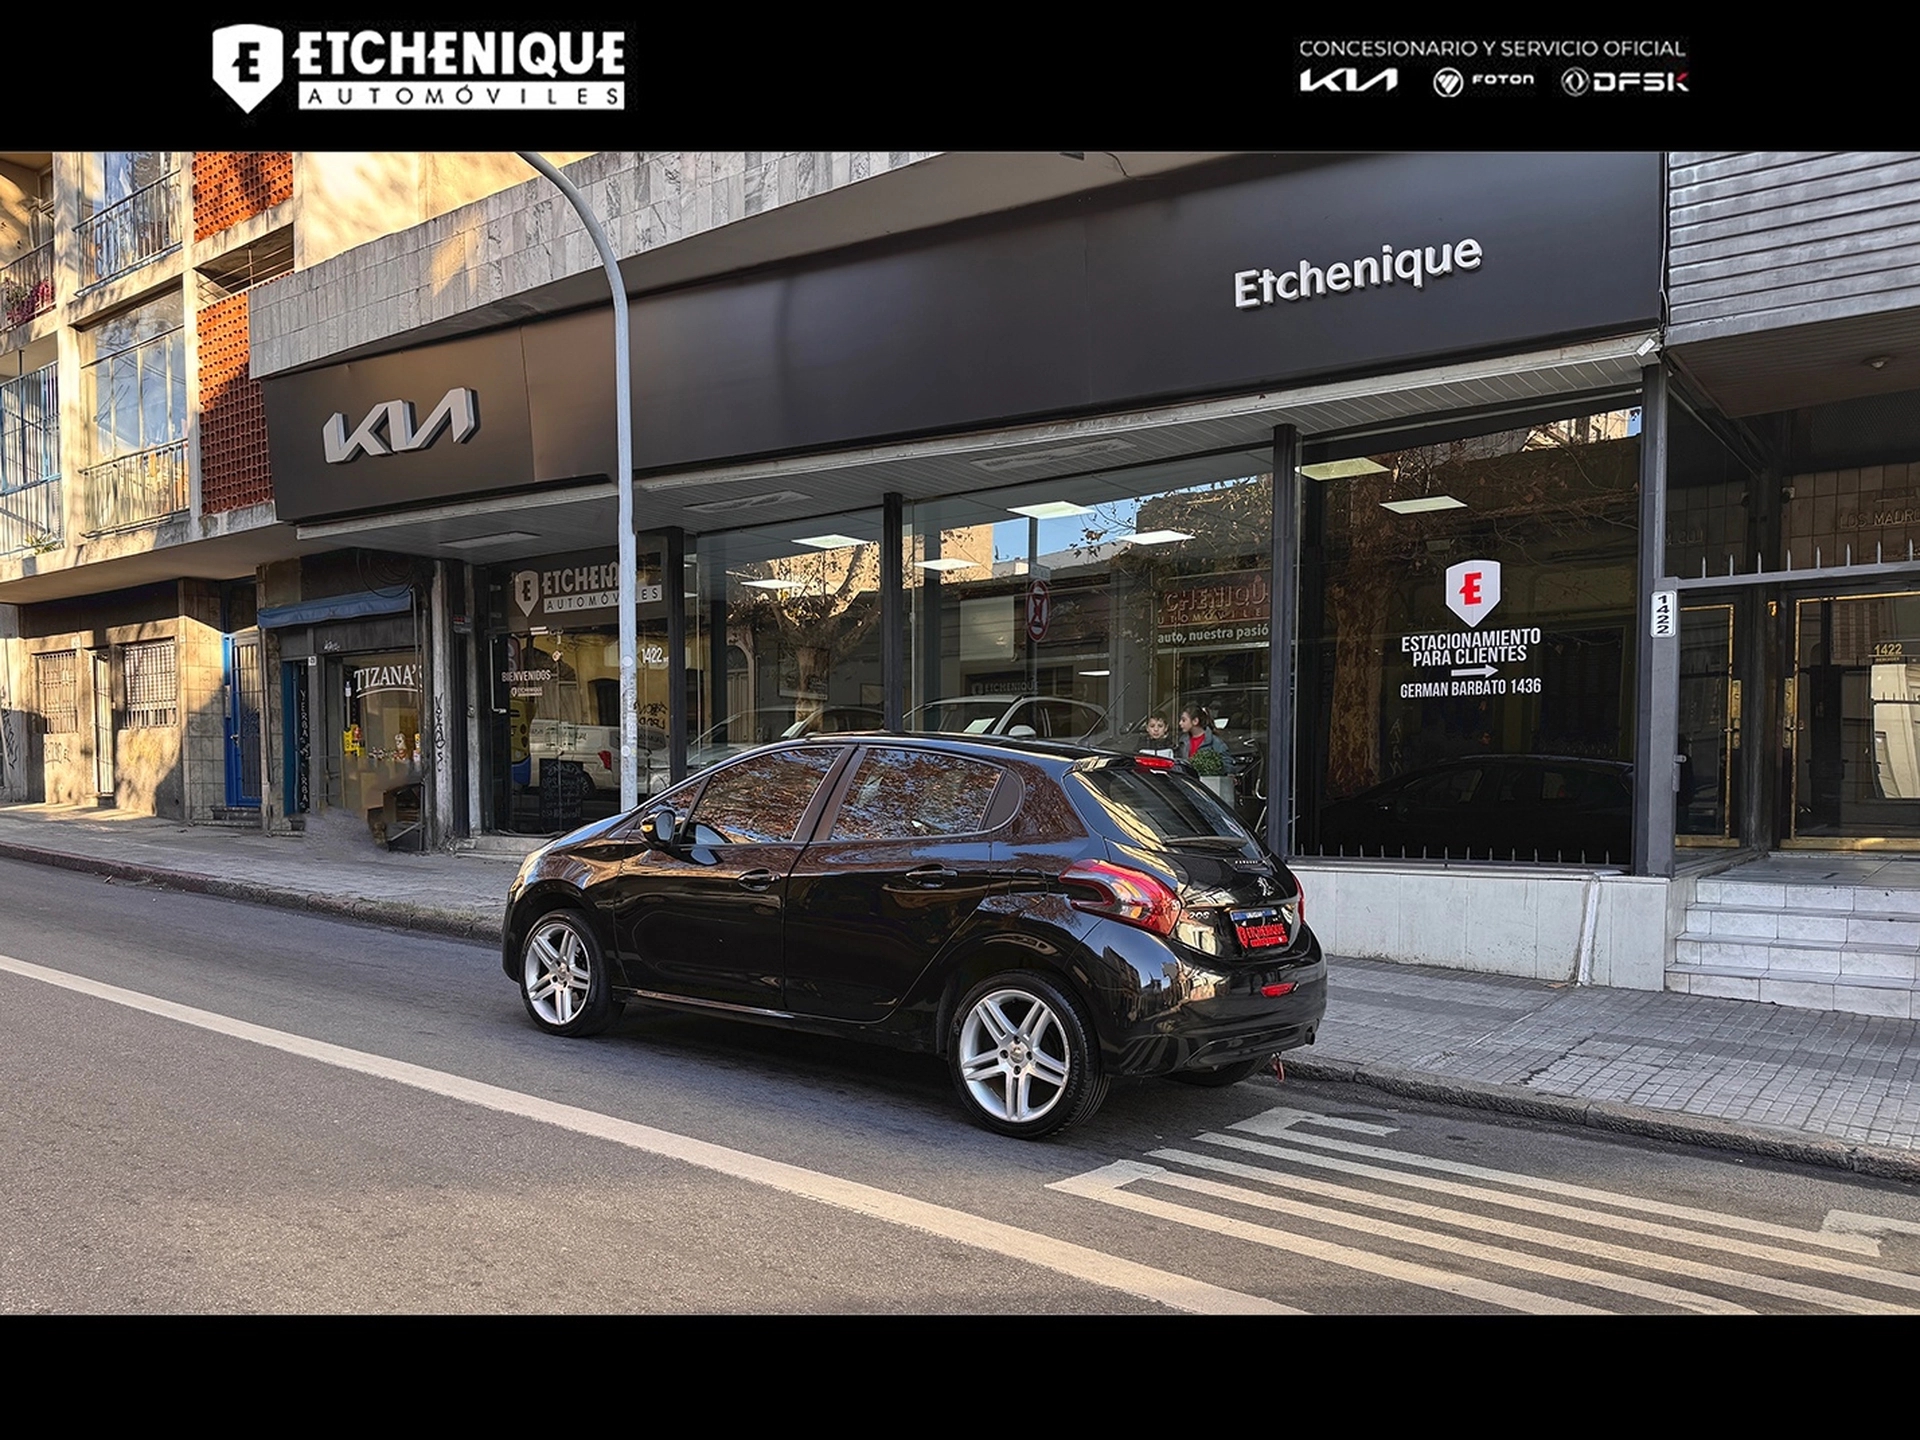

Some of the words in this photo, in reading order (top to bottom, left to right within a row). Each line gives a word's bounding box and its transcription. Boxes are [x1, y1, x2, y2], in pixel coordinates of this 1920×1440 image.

[1234, 238, 1483, 309] Etchenique
[323, 387, 478, 464] KIA
[542, 564, 620, 595] ETCHEN
[546, 587, 658, 611] AUTOMÓVES
[1159, 582, 1270, 612] CHENIQU
[1656, 595, 1670, 634] 1422
[1157, 629, 1187, 643] auto,
[1189, 628, 1234, 641] nuestra
[1236, 623, 1270, 640] pasió
[1401, 627, 1541, 652] ESTACIONAMIENTO
[642, 646, 662, 663] 1422
[1413, 650, 1451, 667] PARA
[1455, 644, 1527, 665] CLIENTES
[1874, 643, 1902, 656] 1422
[353, 664, 423, 692] TIZANA'
[501, 669, 551, 683] BIENVENIDOS
[1400, 682, 1448, 698] GERMAN
[1452, 679, 1506, 696] BARBATO
[1511, 677, 1542, 694] 1436
[1066, 1050, 1080, 1098] KUMHO
